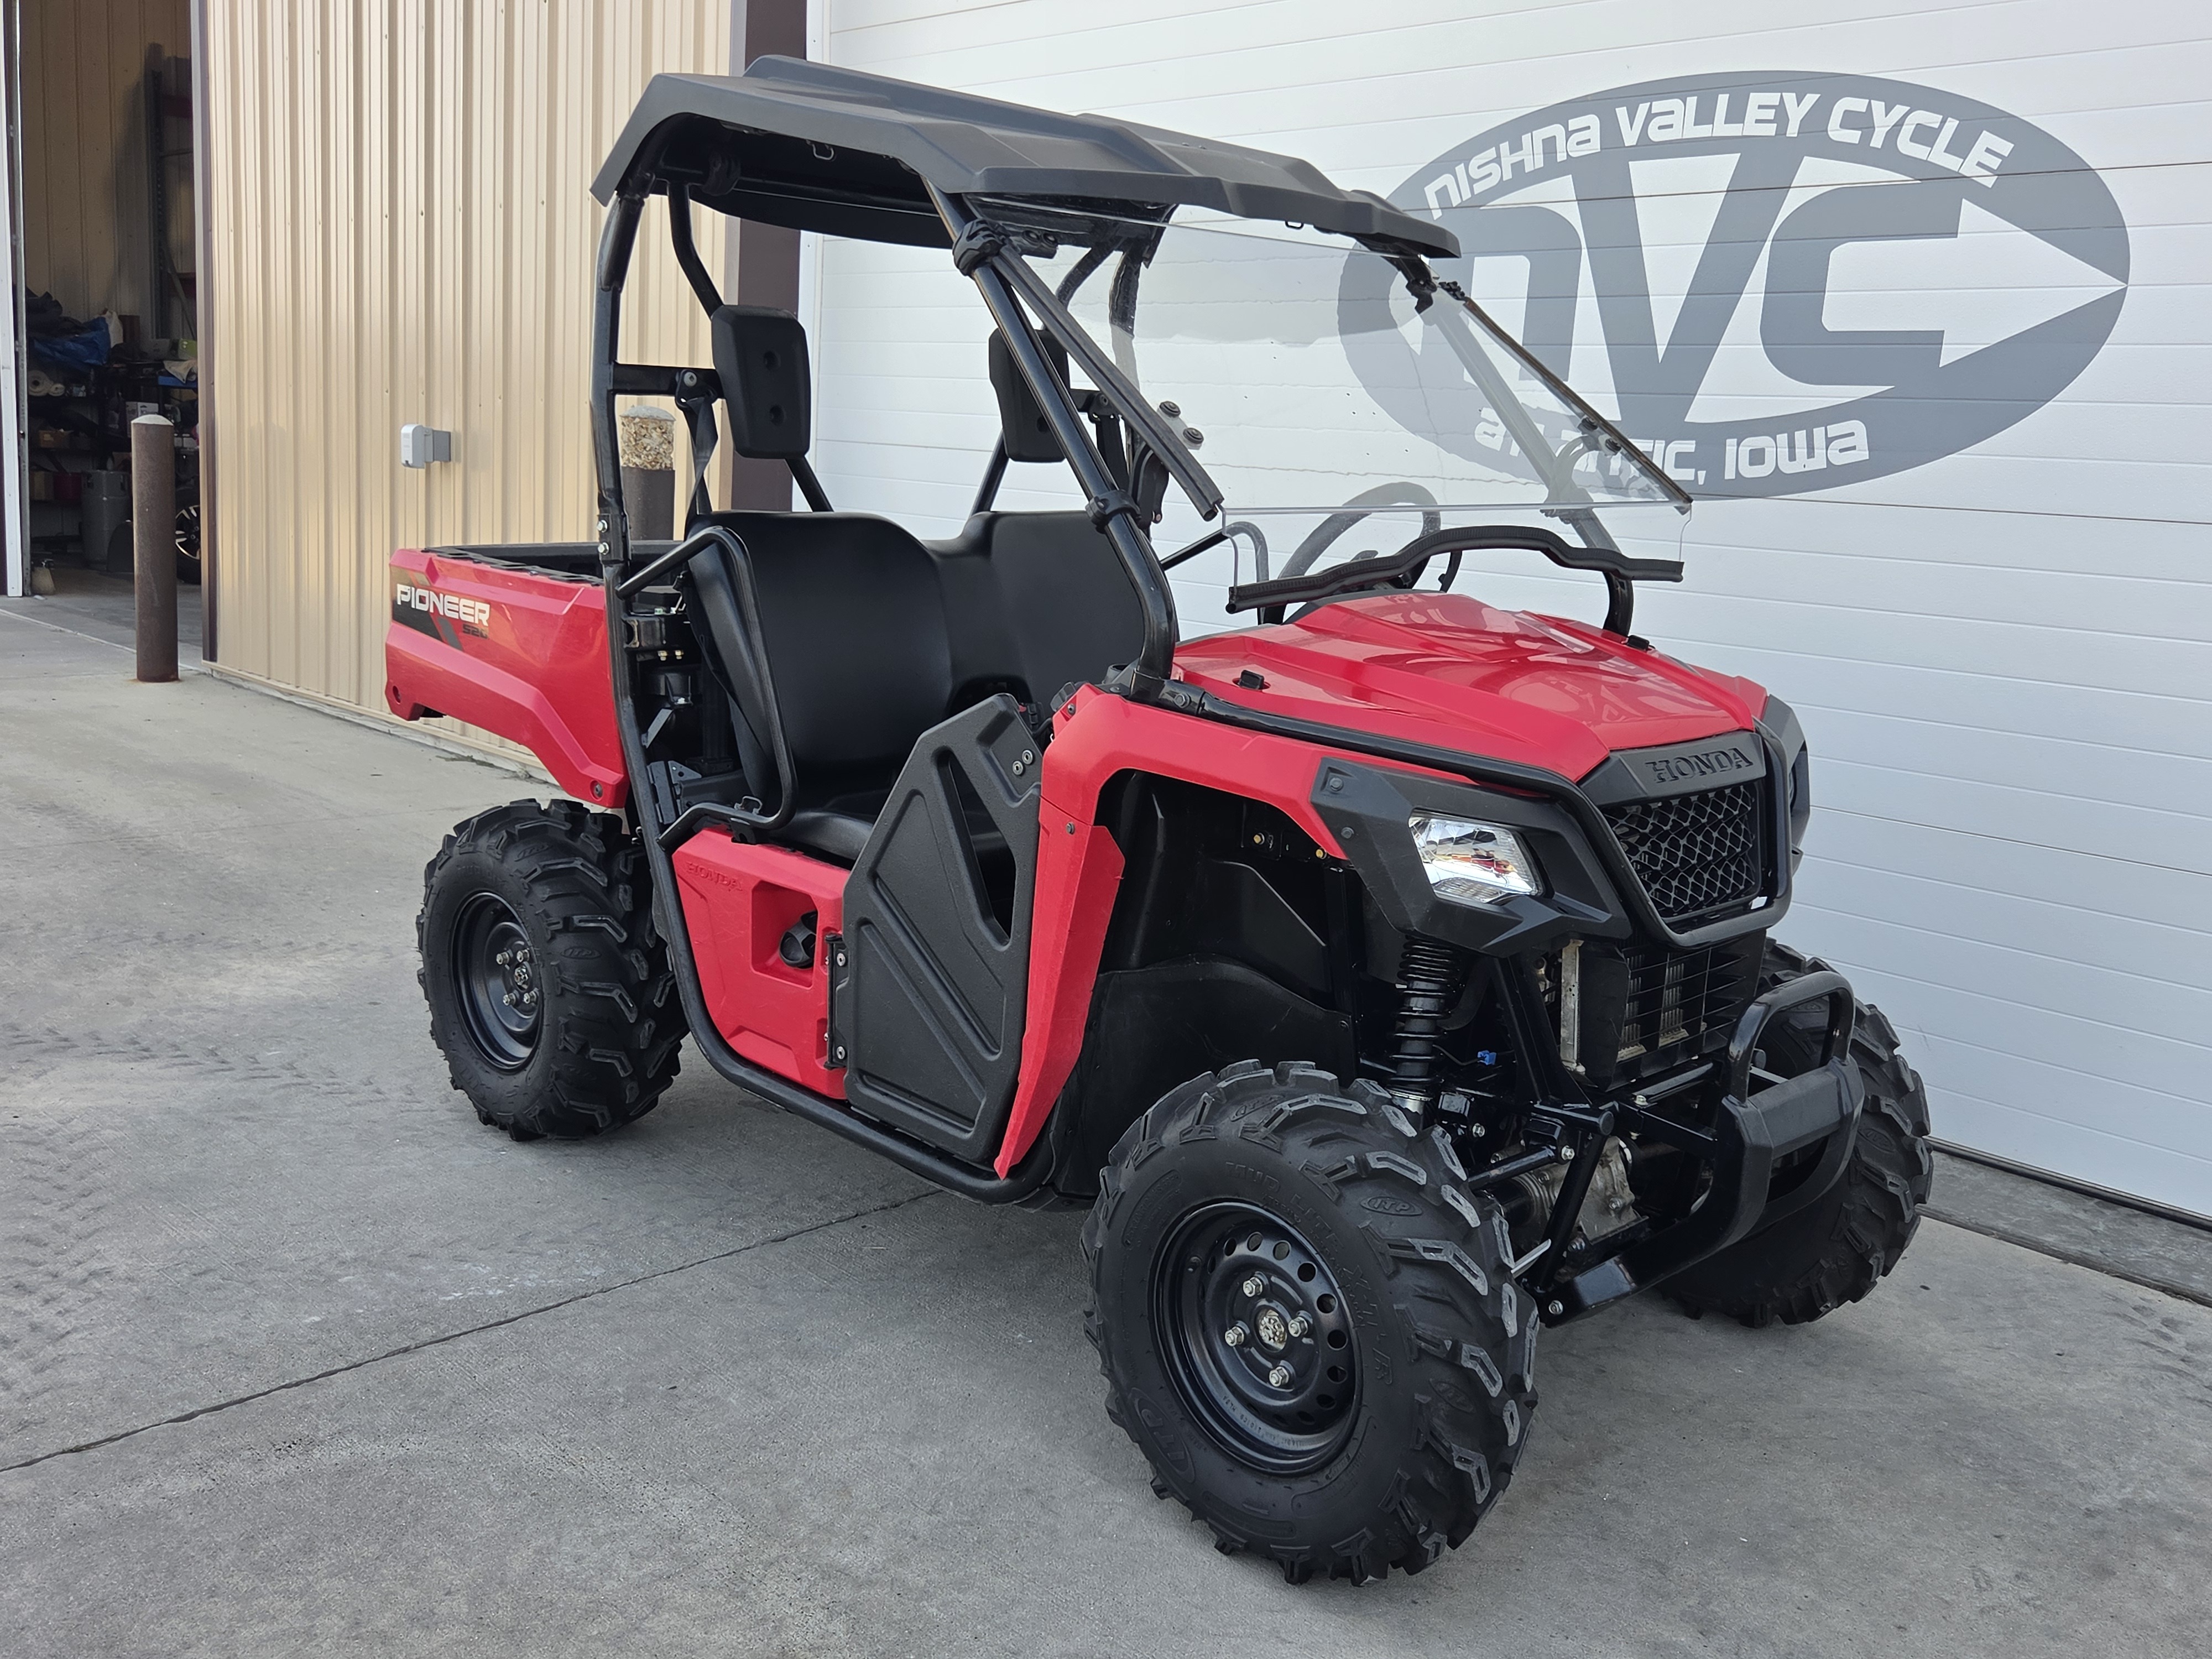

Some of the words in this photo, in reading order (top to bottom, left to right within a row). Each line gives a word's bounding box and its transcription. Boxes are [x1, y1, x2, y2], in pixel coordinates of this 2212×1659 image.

[1827, 97, 2014, 188] CYCLE
[397, 584, 491, 627] PIONEER
[1645, 747, 1754, 784] HONDA
[685, 861, 743, 893] HONDA
[1373, 1198, 1411, 1212] ITP
[1141, 1408, 1185, 1461] ITP
